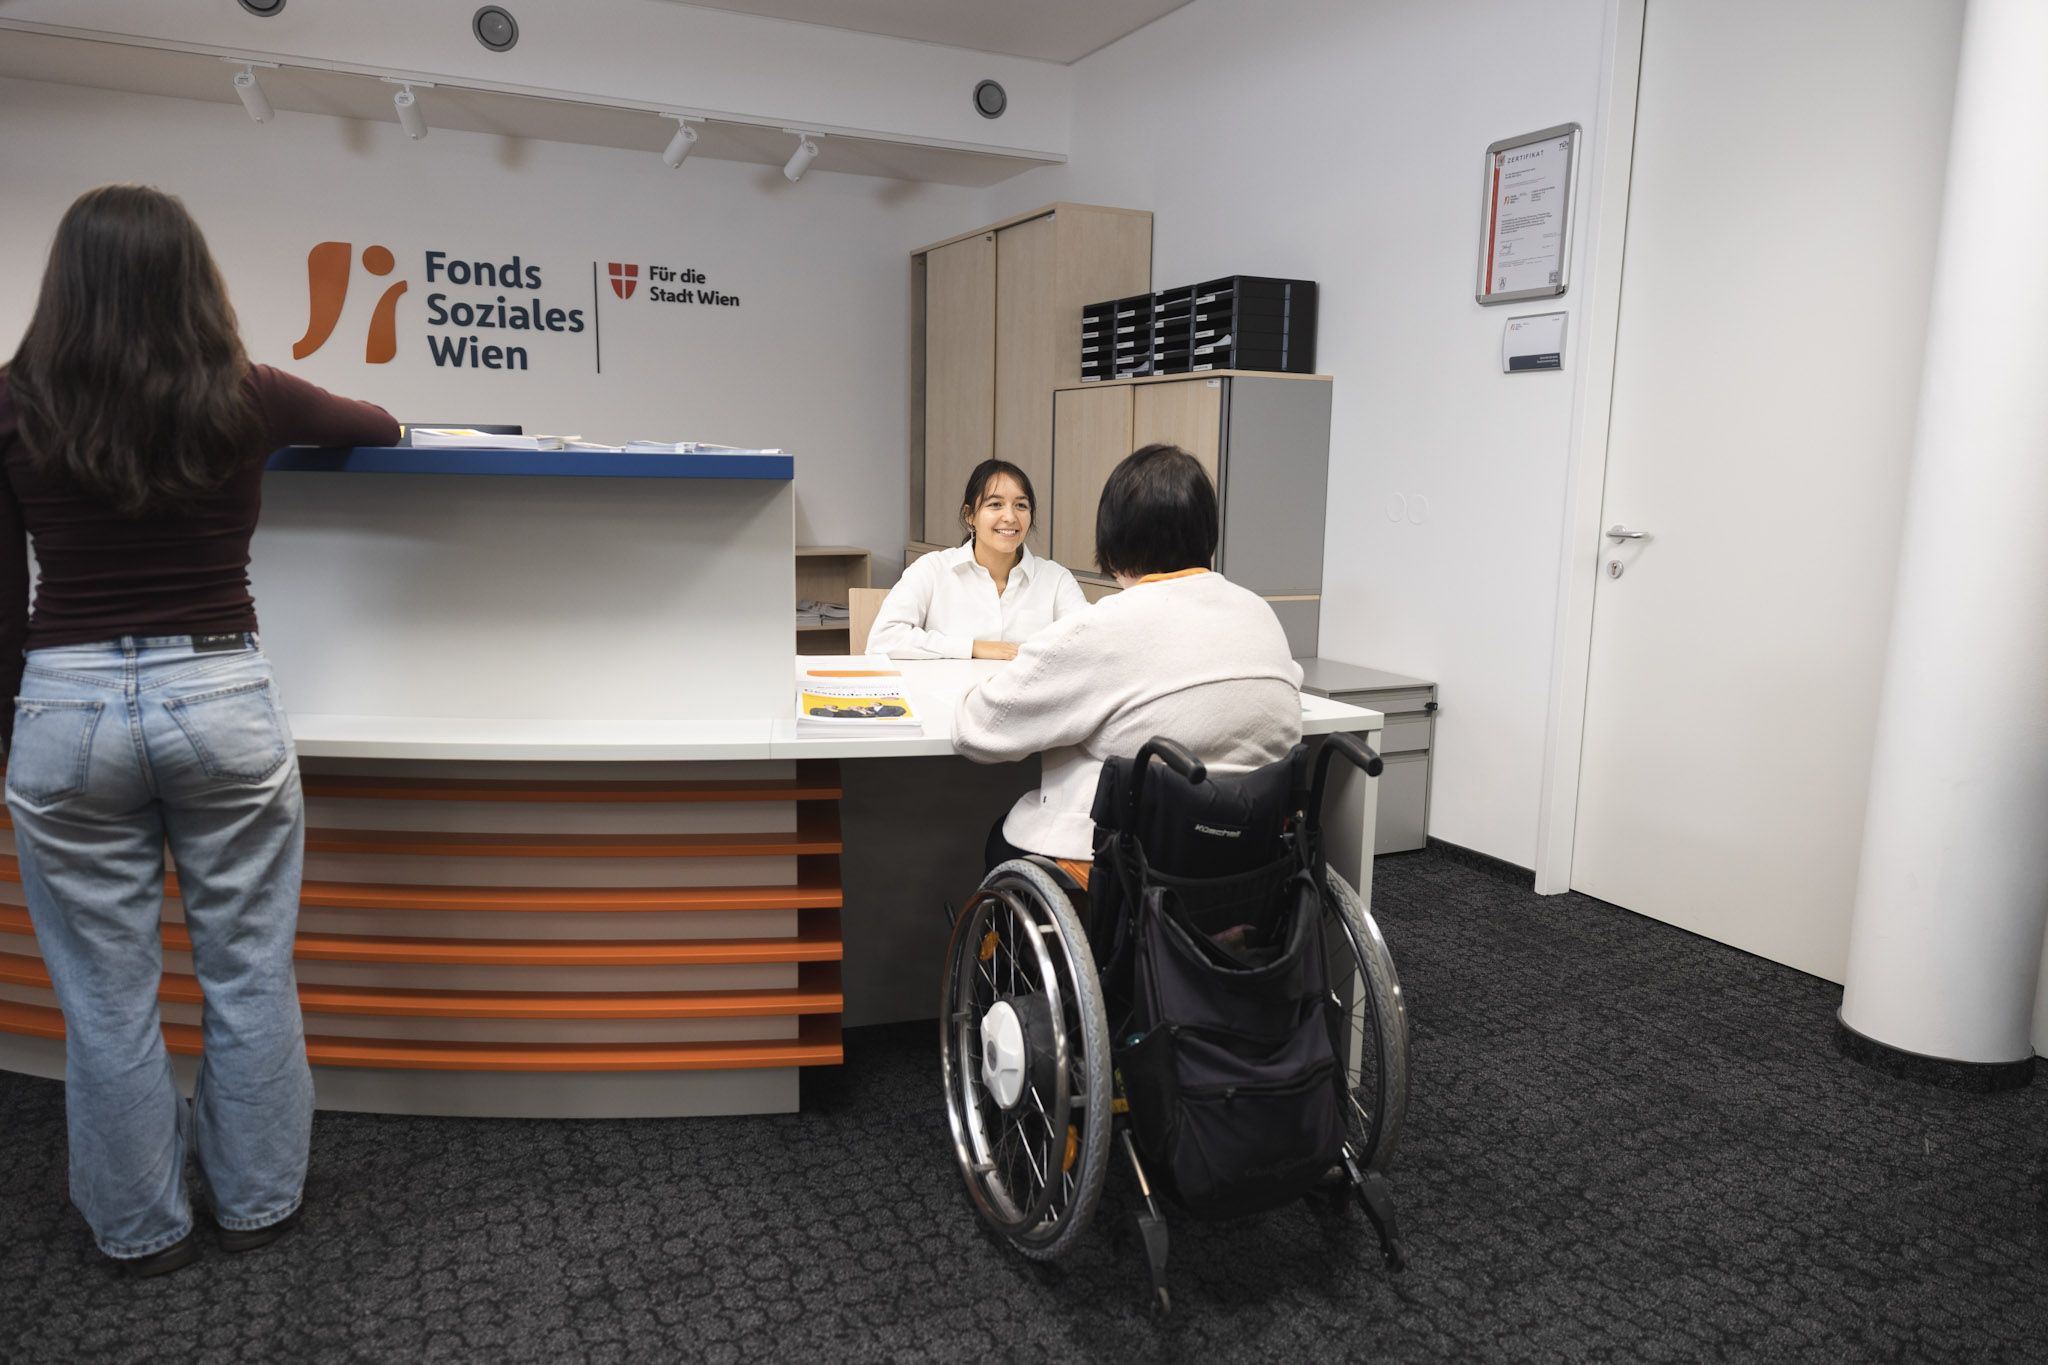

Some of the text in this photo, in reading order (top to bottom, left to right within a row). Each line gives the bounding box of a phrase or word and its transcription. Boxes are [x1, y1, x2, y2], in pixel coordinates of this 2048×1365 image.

[1507, 150, 1544, 164] ZERTIFIKAT
[425, 250, 542, 290] Fonds
[649, 265, 707, 285] Für die
[649, 286, 740, 307] Stadt Wien
[427, 293, 585, 333] Soziales
[426, 335, 528, 371] Wien
